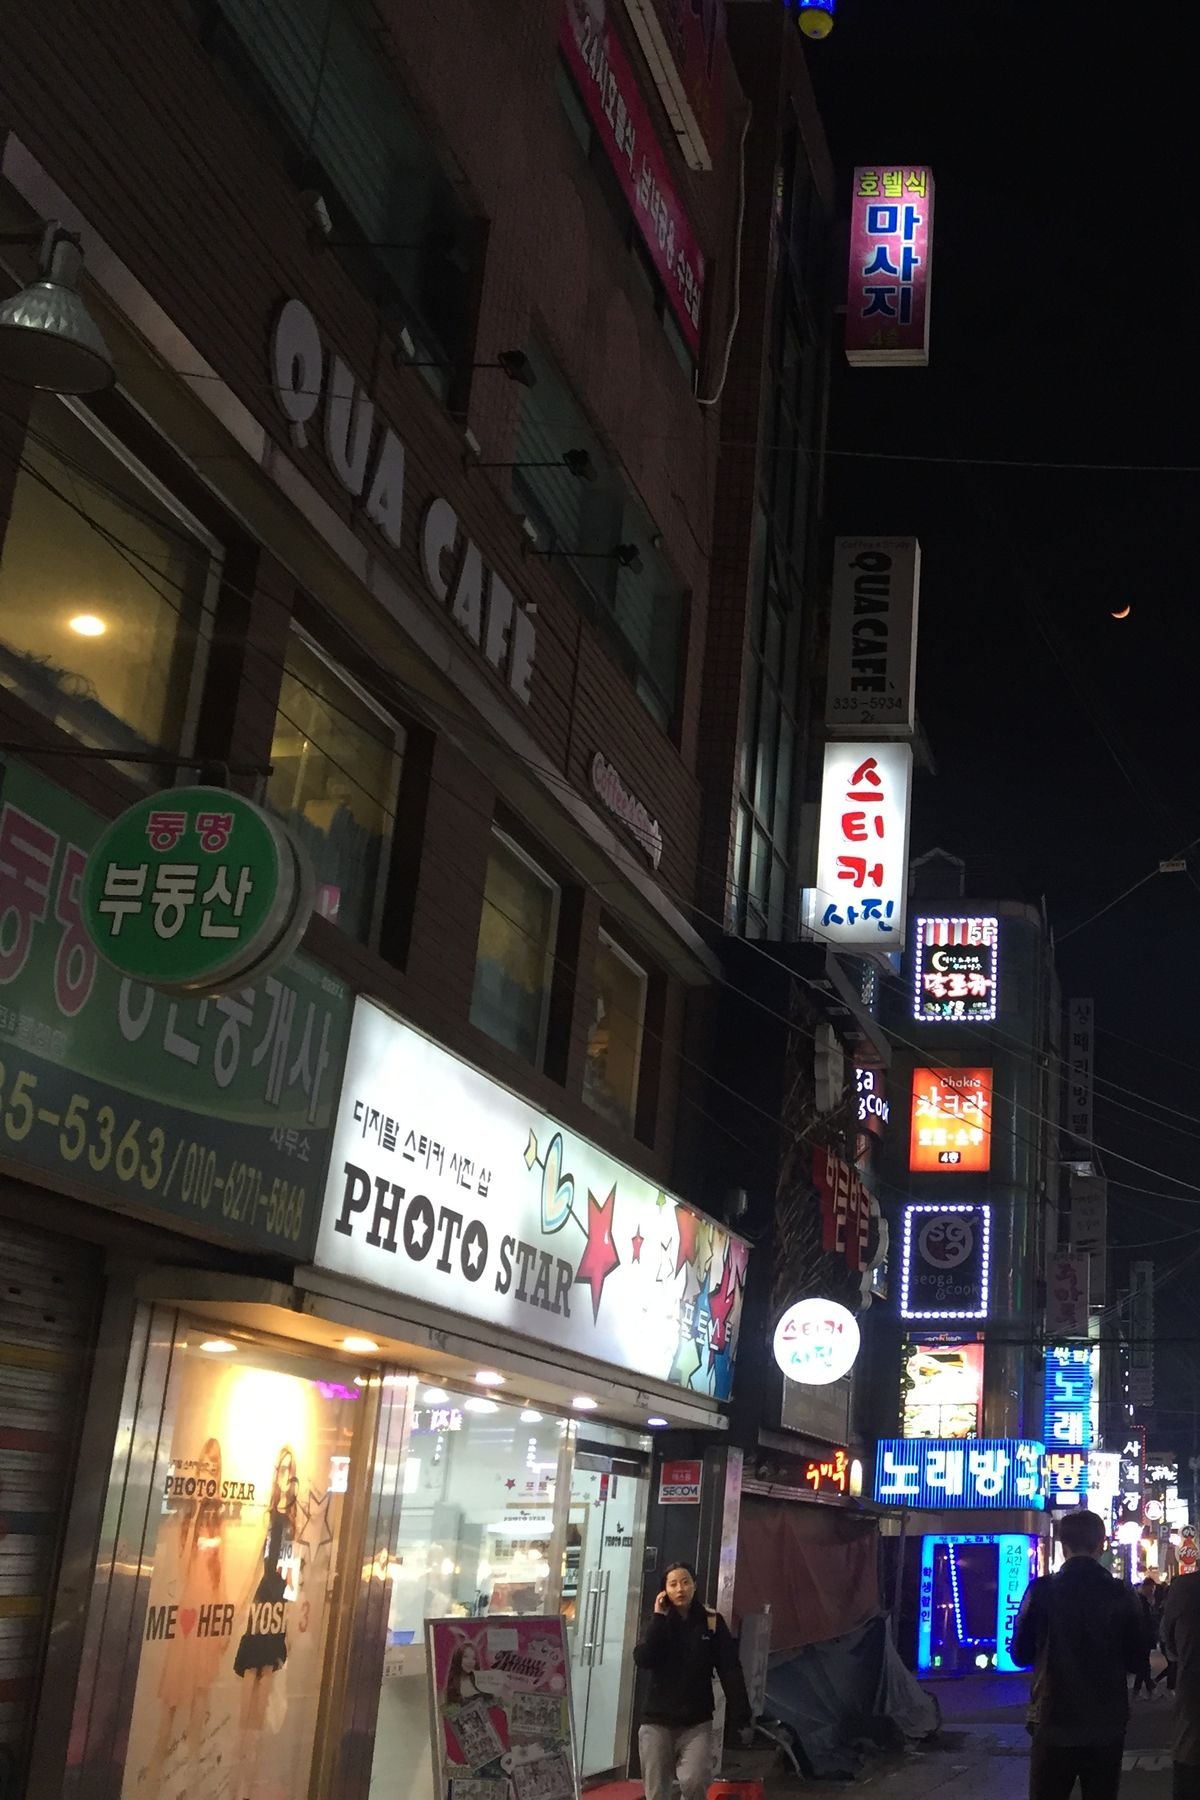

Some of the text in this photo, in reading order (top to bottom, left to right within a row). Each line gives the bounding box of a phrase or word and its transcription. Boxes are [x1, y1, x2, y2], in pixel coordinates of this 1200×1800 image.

[858, 171, 926, 197] 호텔식
[863, 204, 921, 325] 마사지
[273, 298, 405, 549] QUA
[833, 697, 902, 710] 333-5934
[145, 811, 235, 853] 동명
[837, 757, 885, 889] 스티커
[98, 862, 253, 939] 부동산
[820, 899, 895, 932] 사진
[403, 1128, 445, 1177] 스티커
[334, 1162, 575, 1318] PHOTO STAR
[1051, 1371, 1085, 1490] 노래방
[164, 1475, 255, 1500] PHOTO STAR
[662, 1486, 698, 1496] SECOM
[880, 1450, 1011, 1497] 노래방
[1007, 1545, 1022, 1555] 24
[146, 1603, 234, 1641] ME HER
